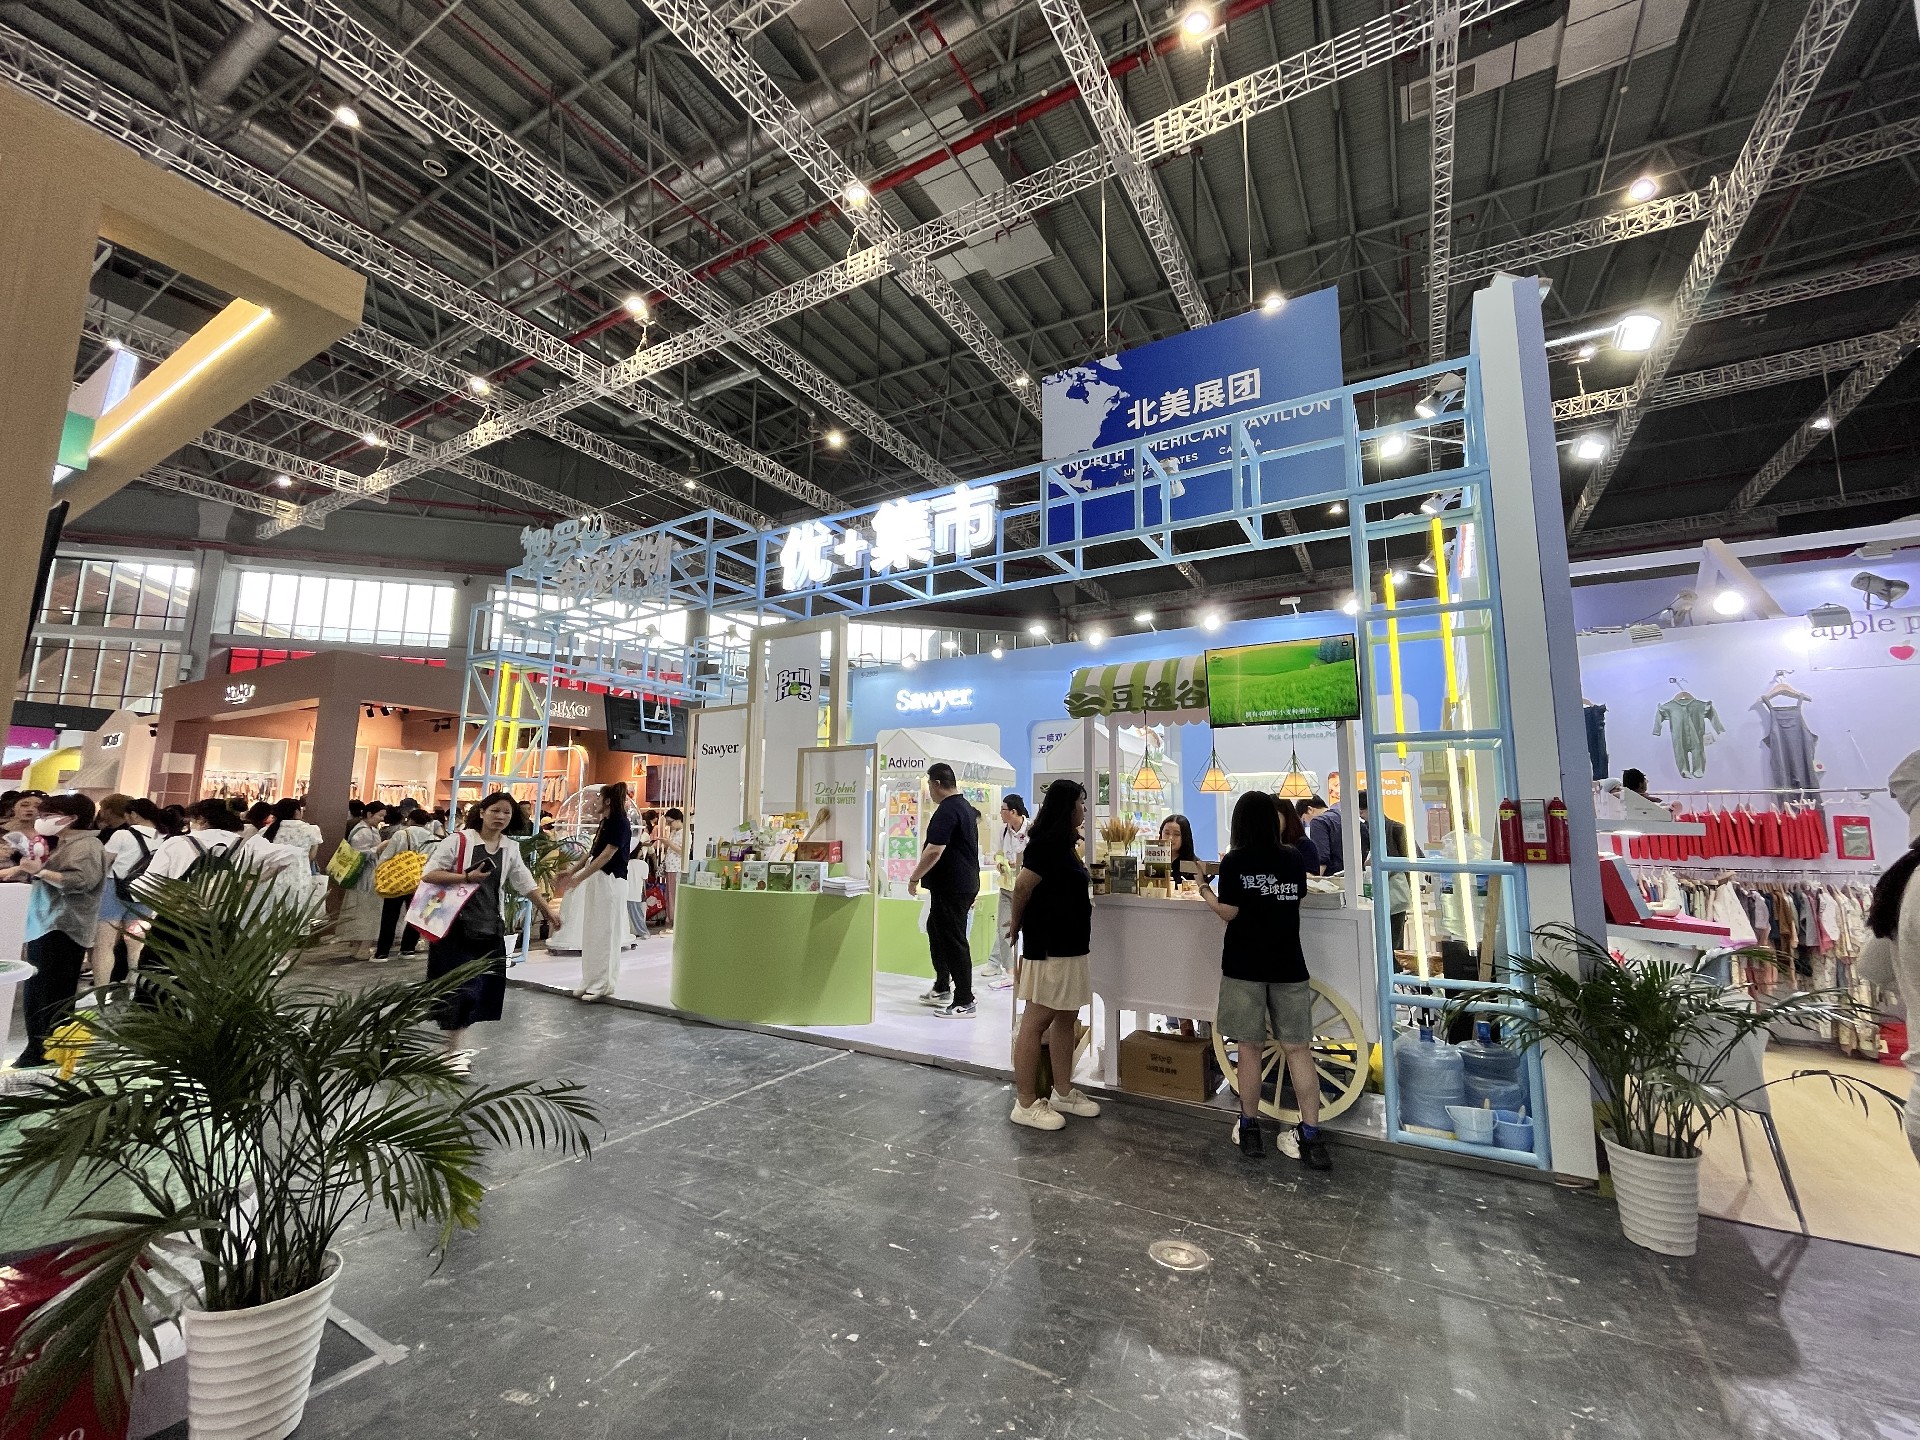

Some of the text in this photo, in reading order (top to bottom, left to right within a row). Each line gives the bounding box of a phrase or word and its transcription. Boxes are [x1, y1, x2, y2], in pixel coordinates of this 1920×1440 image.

[1127, 368, 1260, 430] 北美展团
[1143, 422, 1228, 453] MERICAN
[1243, 399, 1332, 430] AVILION
[1811, 613, 1897, 641] apple
[777, 667, 811, 688] Bull
[896, 688, 974, 714] Sawyer
[1038, 732, 1067, 743] 一喷双
[701, 743, 740, 758] Sawyer
[888, 756, 924, 769] Advion
